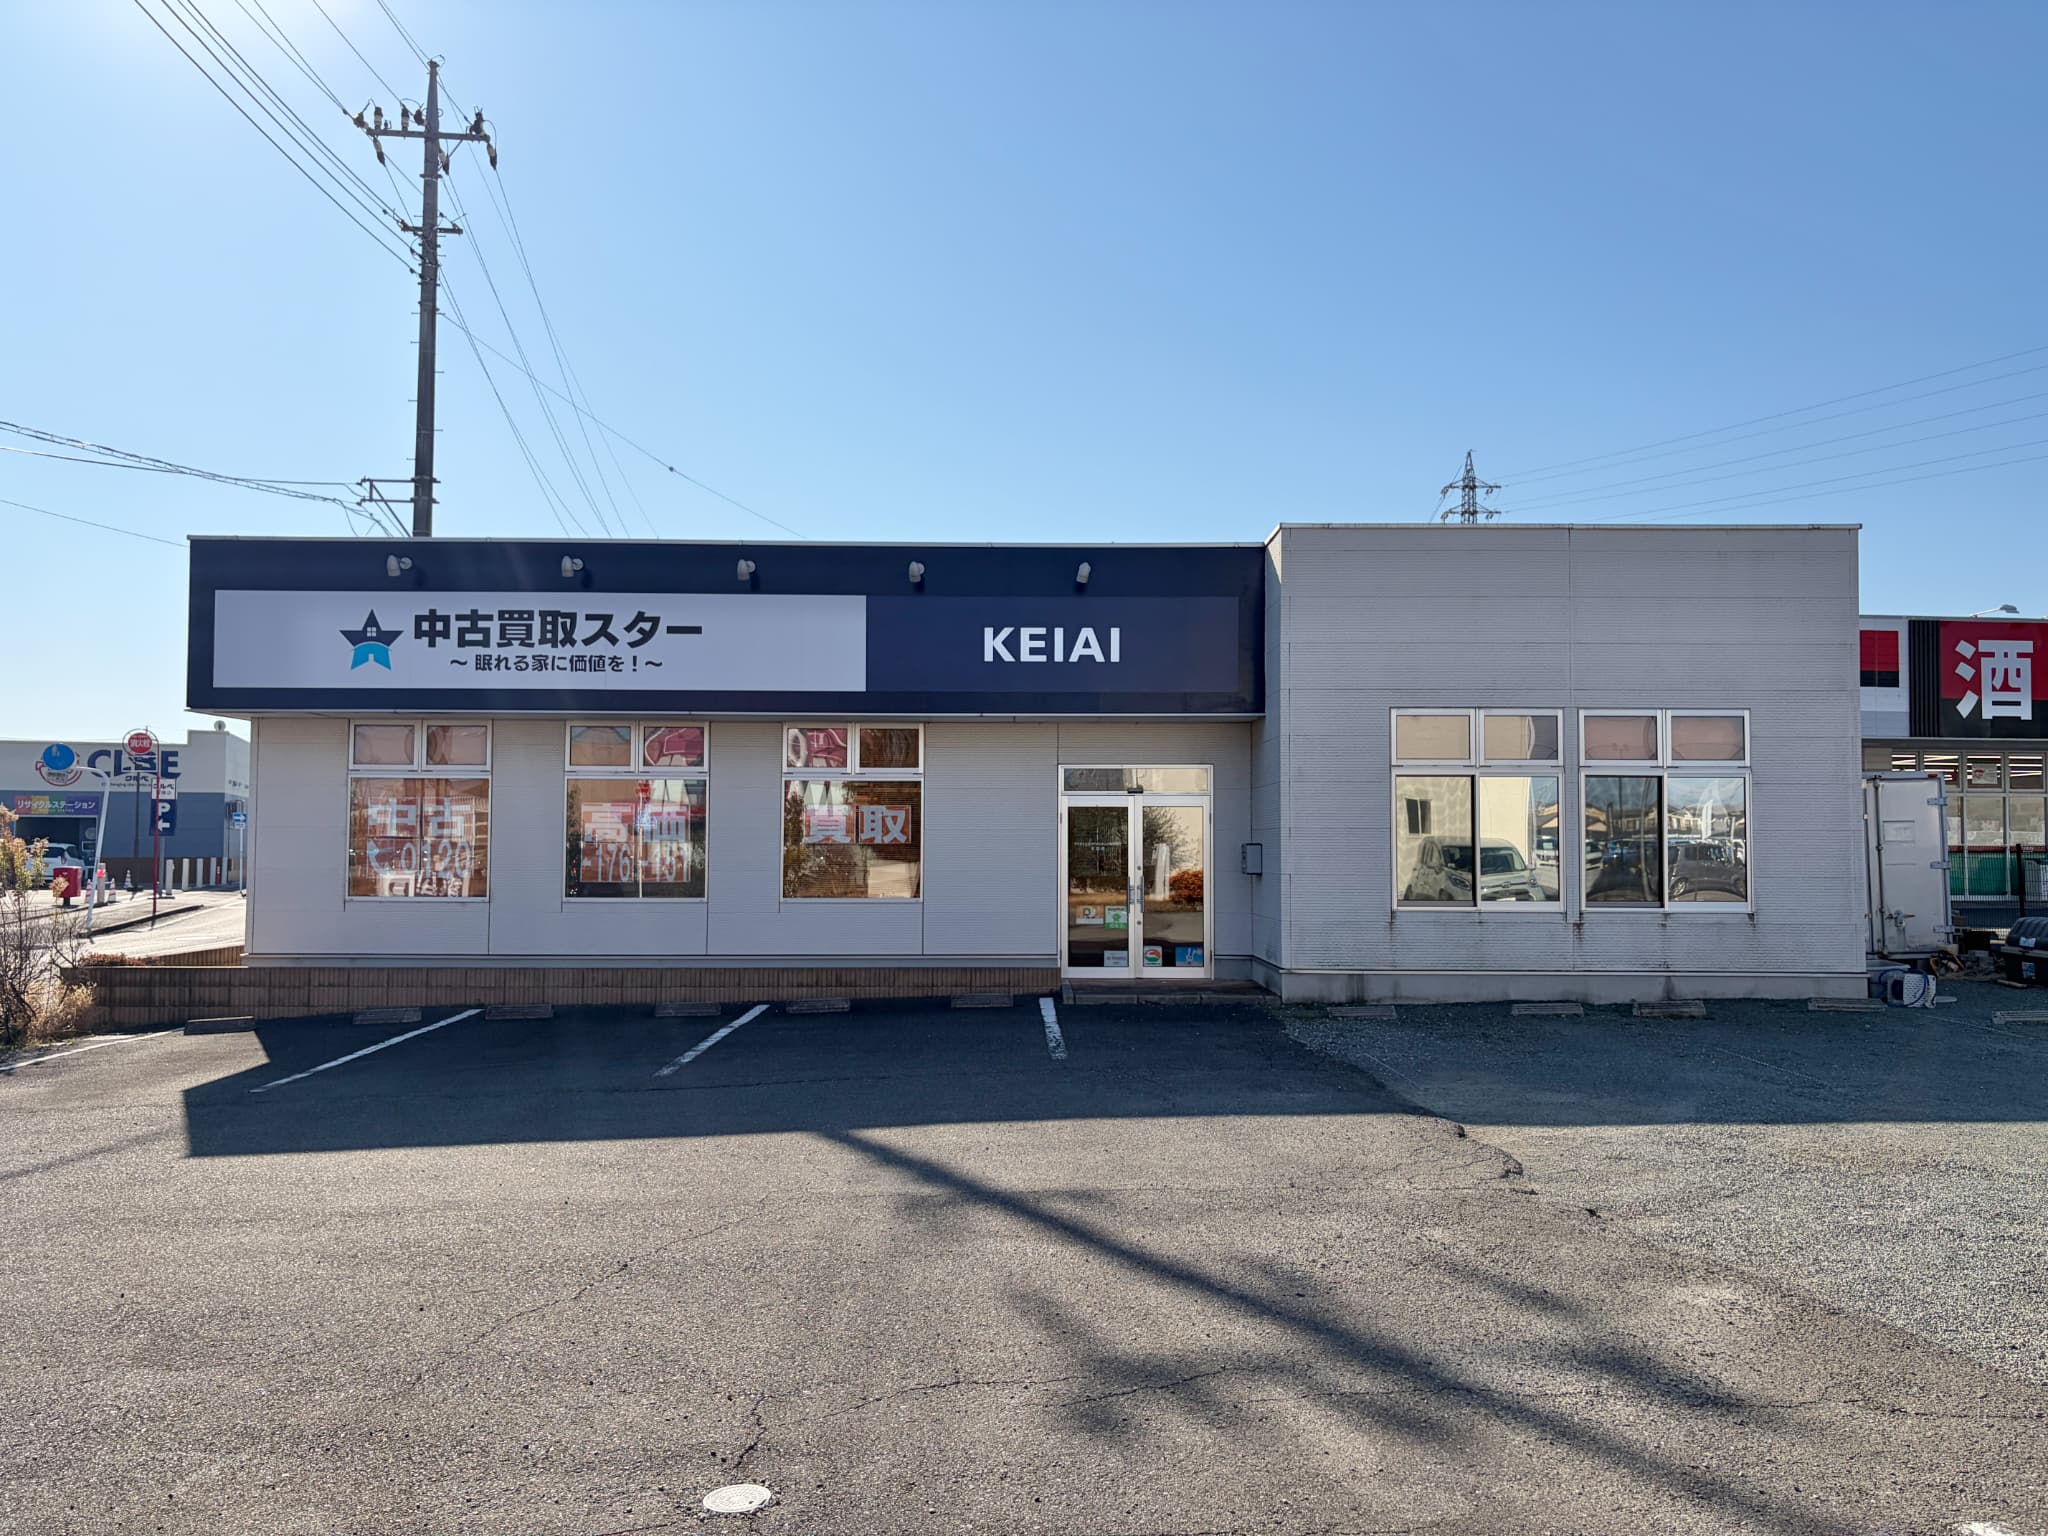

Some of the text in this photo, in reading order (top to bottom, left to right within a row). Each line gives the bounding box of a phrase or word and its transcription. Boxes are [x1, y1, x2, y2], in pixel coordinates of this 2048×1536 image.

[413, 608, 704, 649] 中古買取スター
[984, 627, 1121, 663] KEIAI
[1954, 640, 2034, 720] 酒
[17, 799, 96, 809] リサイクルステーション
[158, 802, 170, 816] P
[368, 797, 472, 837] 中古
[582, 803, 688, 843] 高価
[804, 805, 908, 844] 買取
[401, 839, 471, 879] 0120
